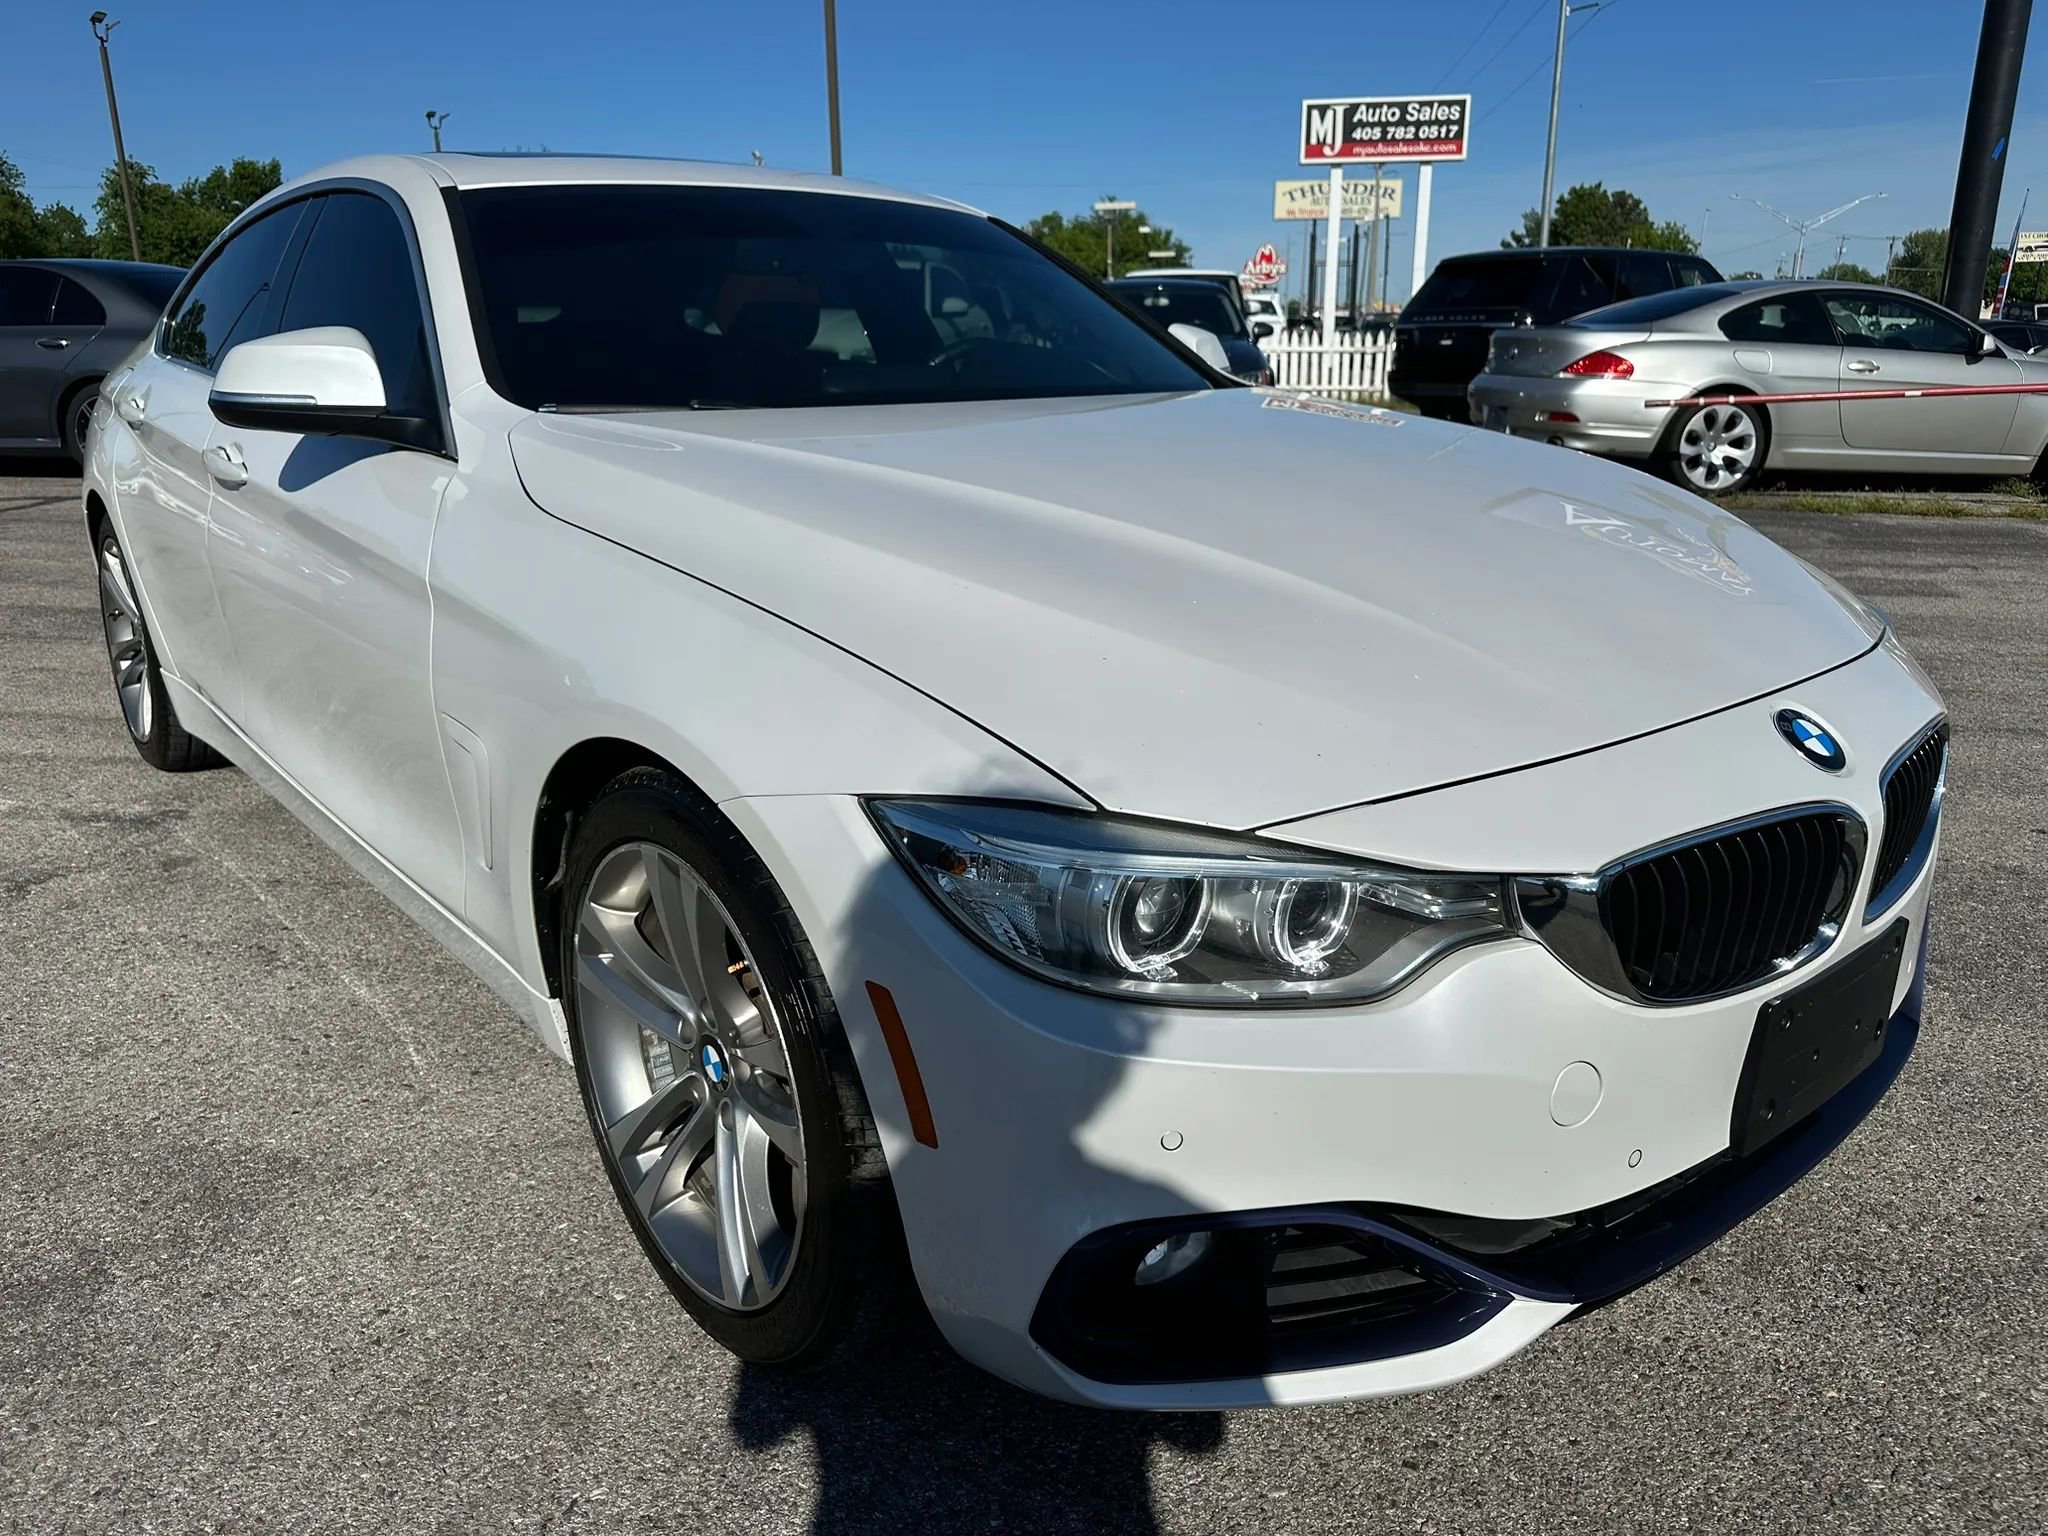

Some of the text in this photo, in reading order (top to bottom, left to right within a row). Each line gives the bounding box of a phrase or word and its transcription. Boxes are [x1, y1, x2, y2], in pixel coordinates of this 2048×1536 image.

[1352, 102, 1461, 123] Auto Sales
[1310, 104, 1350, 157] MJ
[1351, 124, 1459, 140] 405 782 0517
